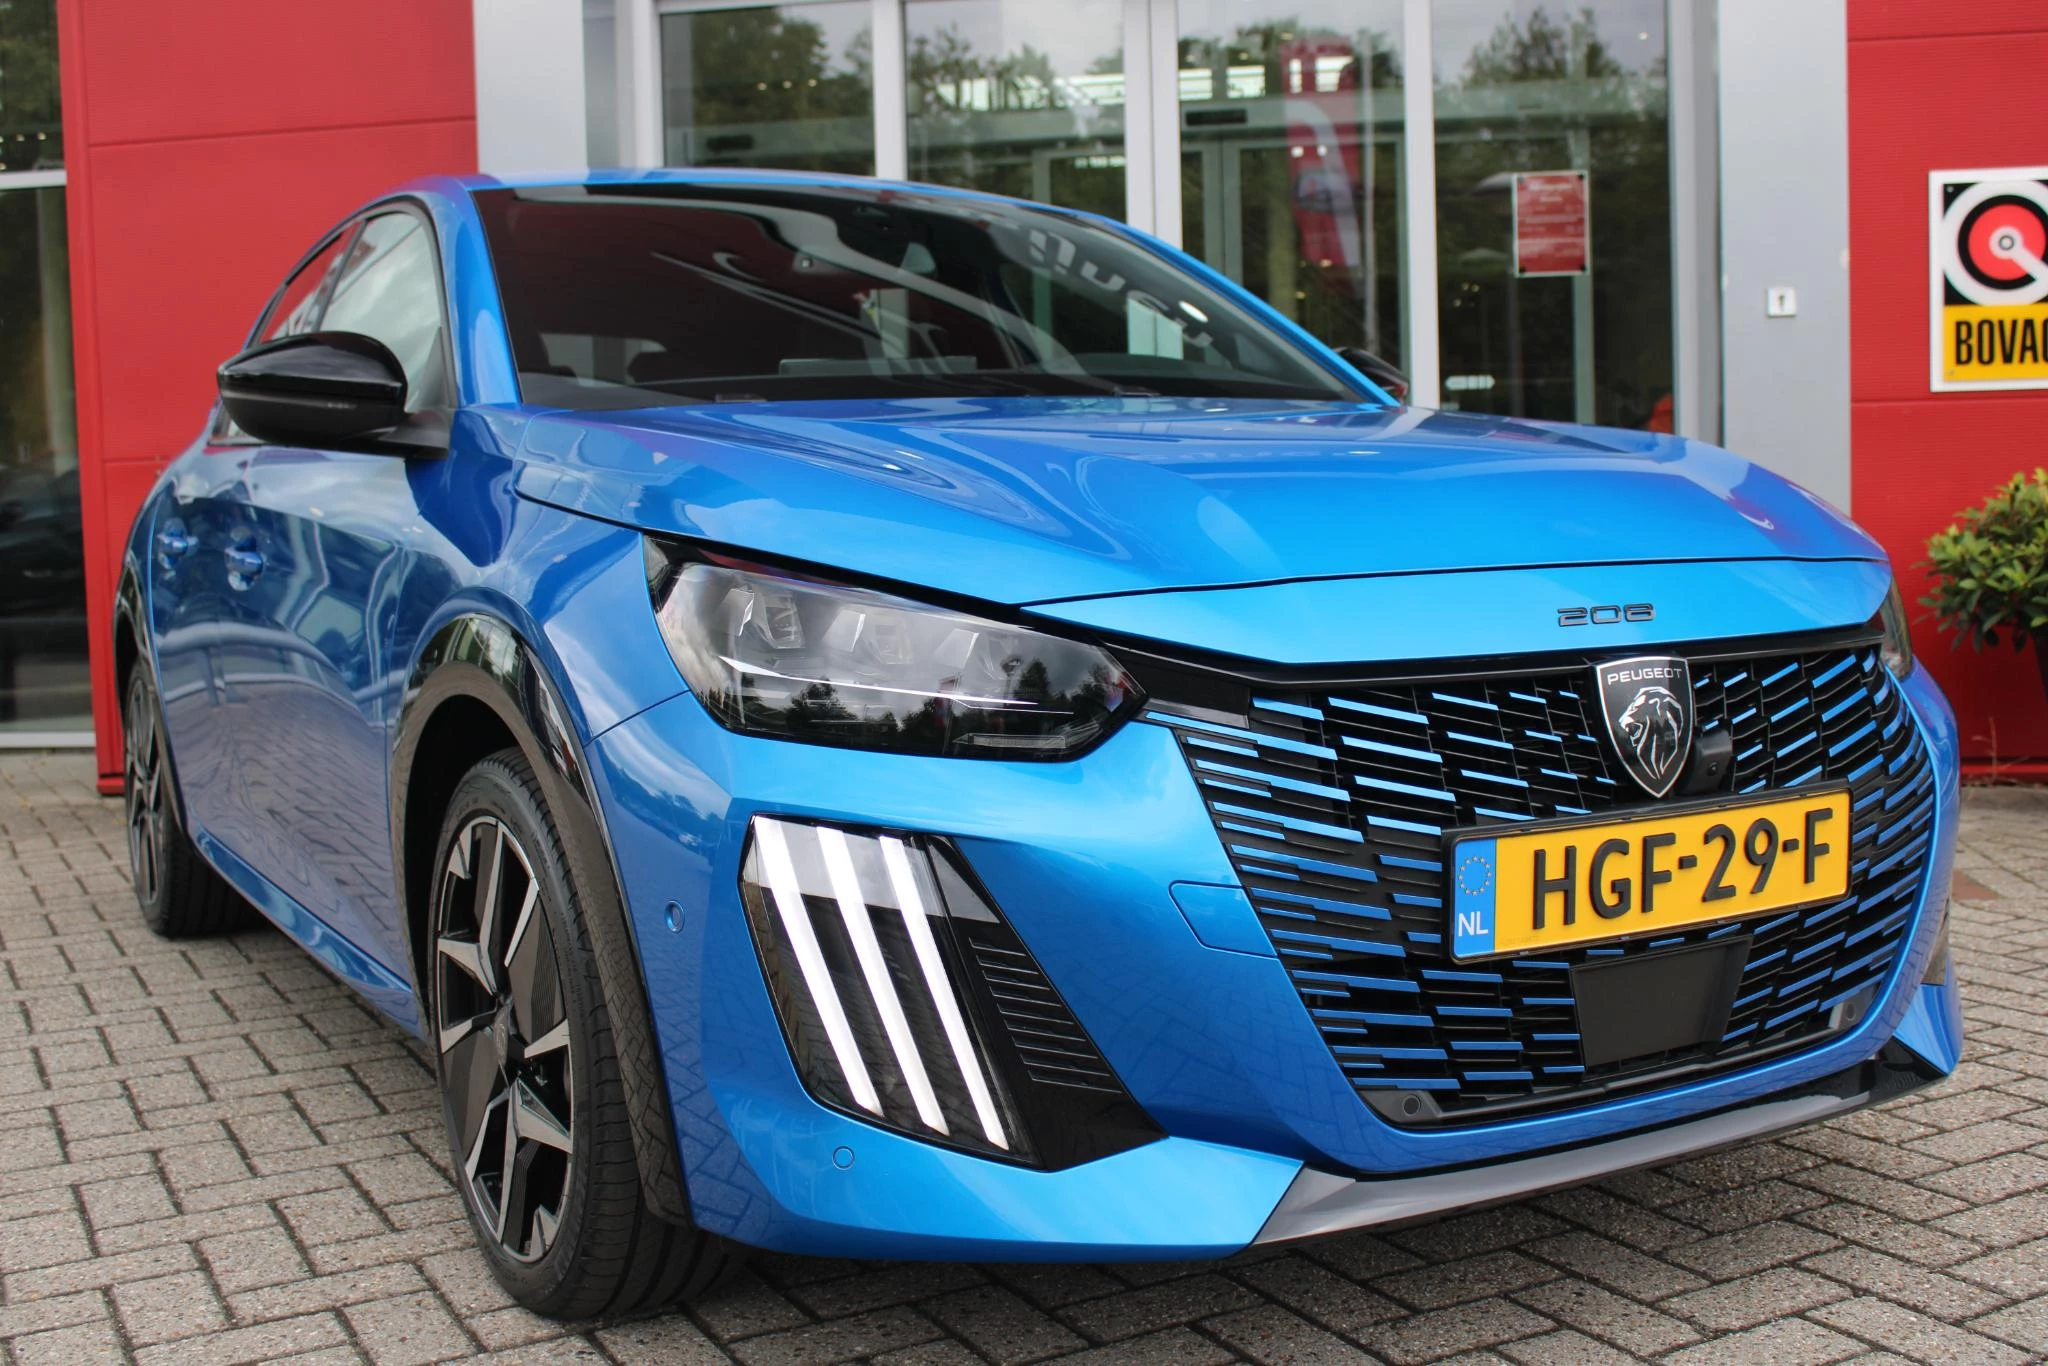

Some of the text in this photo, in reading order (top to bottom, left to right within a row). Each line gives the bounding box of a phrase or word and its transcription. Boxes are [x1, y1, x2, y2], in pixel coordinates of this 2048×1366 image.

[1557, 603, 1656, 627] 208
[1607, 667, 1682, 685] PEUGEOT
[1532, 808, 1834, 931] HGF-29-F
[1458, 911, 1489, 937] NL
